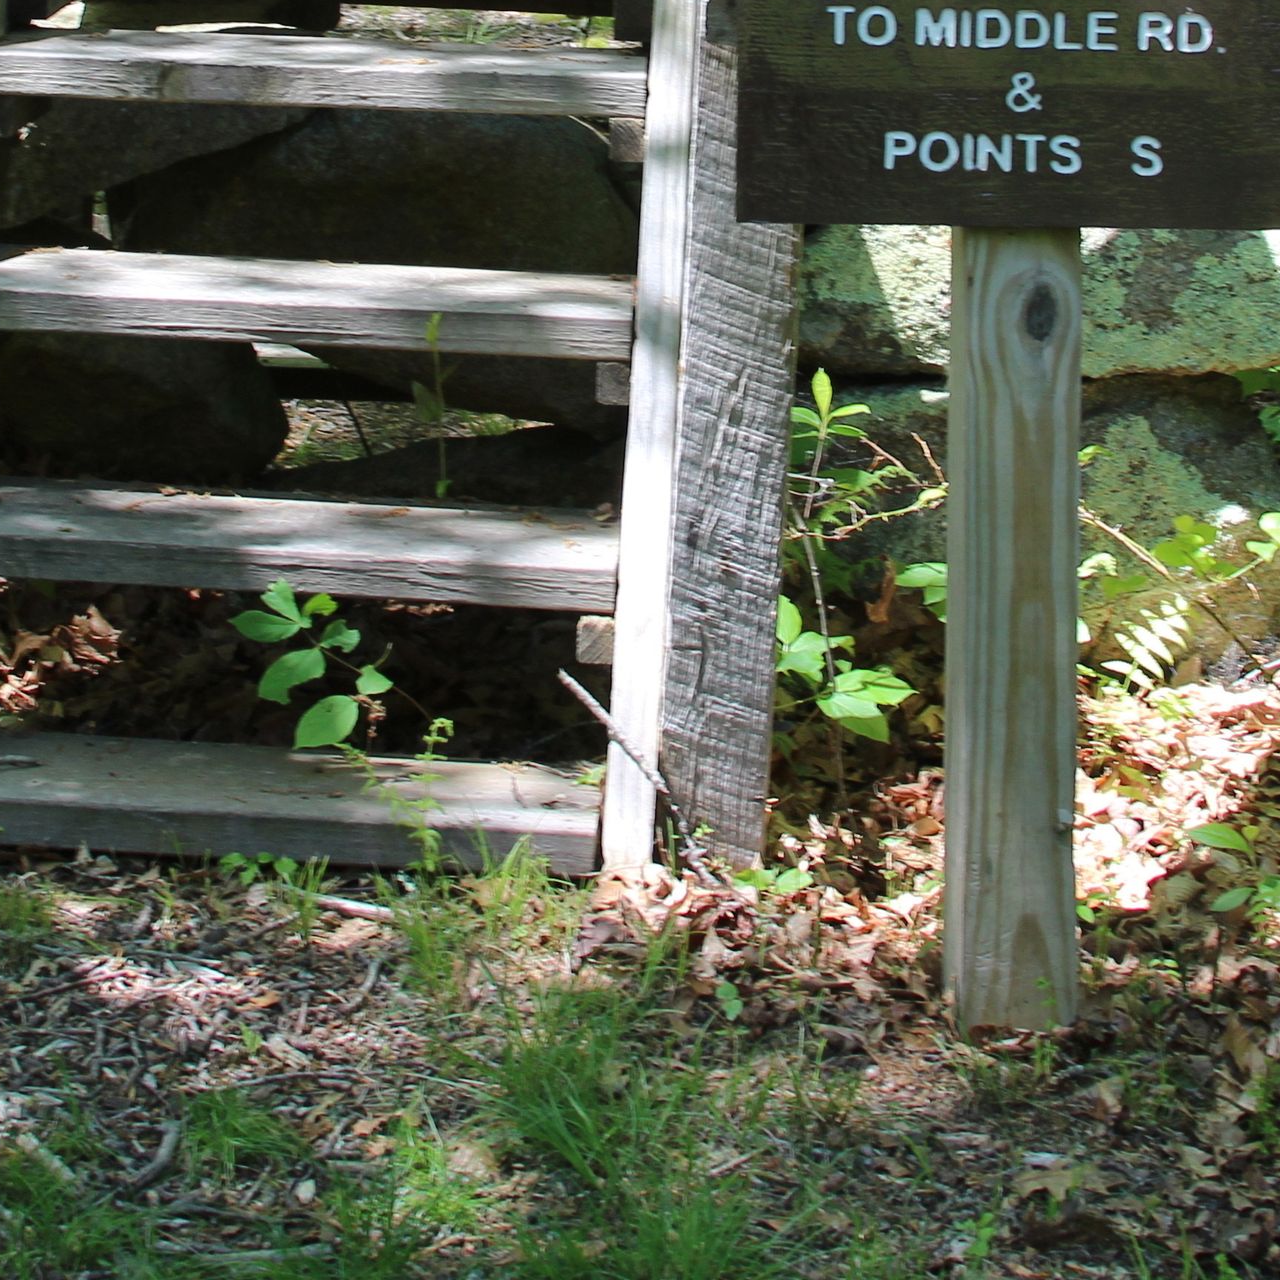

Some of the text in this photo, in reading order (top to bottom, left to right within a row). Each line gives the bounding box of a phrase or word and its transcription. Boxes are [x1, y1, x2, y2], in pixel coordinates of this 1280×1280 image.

[827, 6, 1227, 54] TO MIDDLE RD.
[1006, 72, 1042, 113] &
[883, 131, 1163, 176] POINTS S
